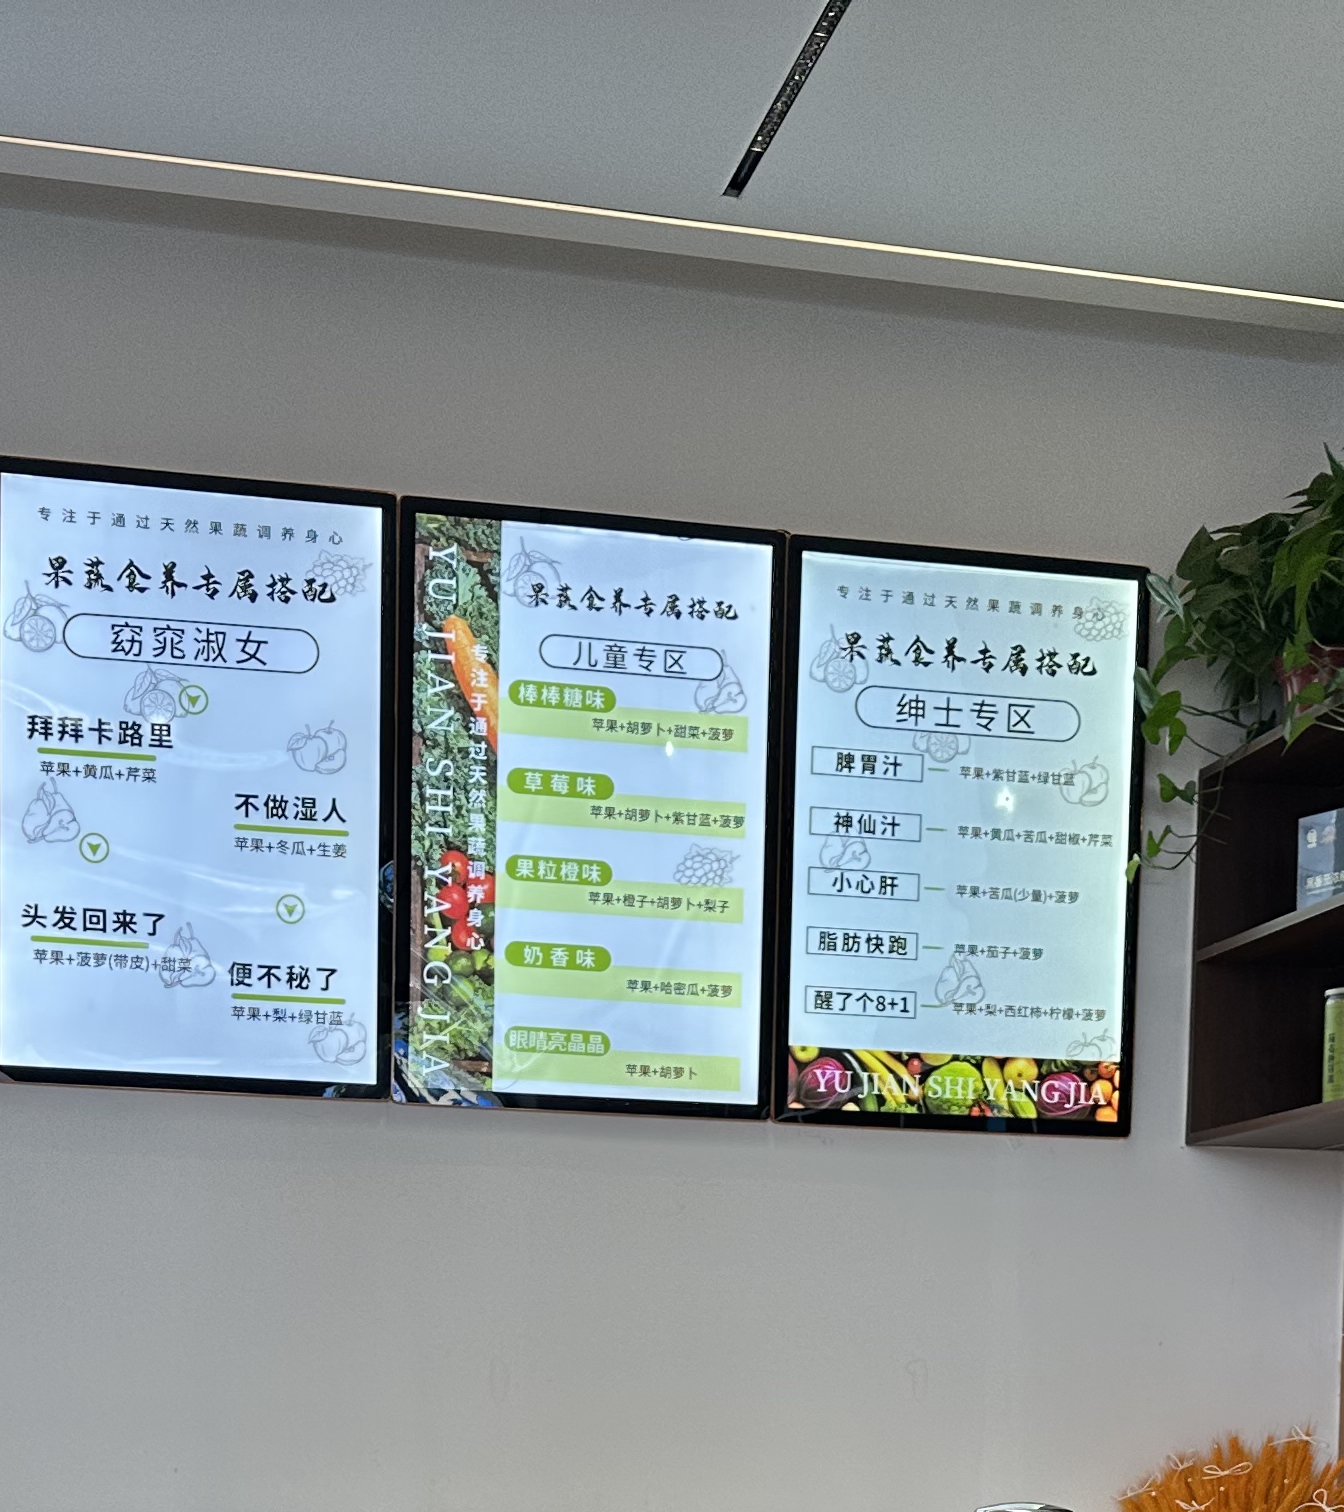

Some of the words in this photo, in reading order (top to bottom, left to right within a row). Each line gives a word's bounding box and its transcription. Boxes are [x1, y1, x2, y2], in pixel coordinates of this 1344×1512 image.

[37, 506, 344, 546] 专注于通过天然果蔬调养身心
[42, 556, 337, 603] 果蔬食养专属搭配
[429, 544, 456, 602] YU
[528, 583, 739, 621] 果蔬食养专属搭配
[837, 584, 1106, 622] 专注于通过天然果蔬调养身心
[110, 621, 269, 667] 窈窕淑女
[573, 641, 688, 675] 儿童专区
[839, 632, 1097, 678] 果蔬食养专属搭配
[422, 622, 456, 733] JIAN
[518, 682, 606, 709] 棒棒糖味
[896, 693, 1035, 734] 绅士专区
[27, 714, 174, 749] 拜拜卡路里
[592, 717, 734, 742] 苹果+胡萝卜+甜菜+菠萝
[40, 760, 157, 785] 苹果+黄瓜+芹菜
[835, 752, 903, 777] 脾胃汁
[465, 643, 489, 951] 专注于通过天然果蔬调养身心
[524, 772, 596, 797] 草莓味
[234, 793, 348, 824] 不做湿人
[590, 805, 745, 829] 苹果+胡萝卜+紫甘蓝+菠萝
[834, 812, 900, 836] 神仙汁
[234, 836, 347, 859] 苹果+冬瓜+生姜
[515, 858, 602, 883] 果粒橙味
[832, 873, 899, 897] 小心肝
[588, 891, 730, 914] 苹果+橙子+胡萝卜+梨子
[21, 903, 166, 936] 头发回来了
[422, 862, 452, 986] YANG
[523, 945, 596, 968] 奶香味
[818, 931, 908, 956] 脂肪快跑
[954, 943, 1044, 961] 苹果+茄子+菠萝
[33, 948, 193, 974] 苹果+菠萝(带皮)+甜菜
[228, 962, 339, 991] 便不秘了
[626, 980, 733, 998] 苹果+哈密瓜+菠萝
[231, 1005, 345, 1026] 苹果+梨+绿甘蓝
[814, 990, 910, 1014] 醒了个8+1
[509, 1029, 606, 1055] 眼睛亮晶晶
[626, 1064, 698, 1080] 苹果+胡萝卜
[815, 1069, 852, 1094] YU
[858, 1072, 922, 1098] JIAN
[928, 1075, 978, 1100] SHI
[983, 1078, 1060, 1104] YANG
[1064, 1081, 1107, 1108] JIA
